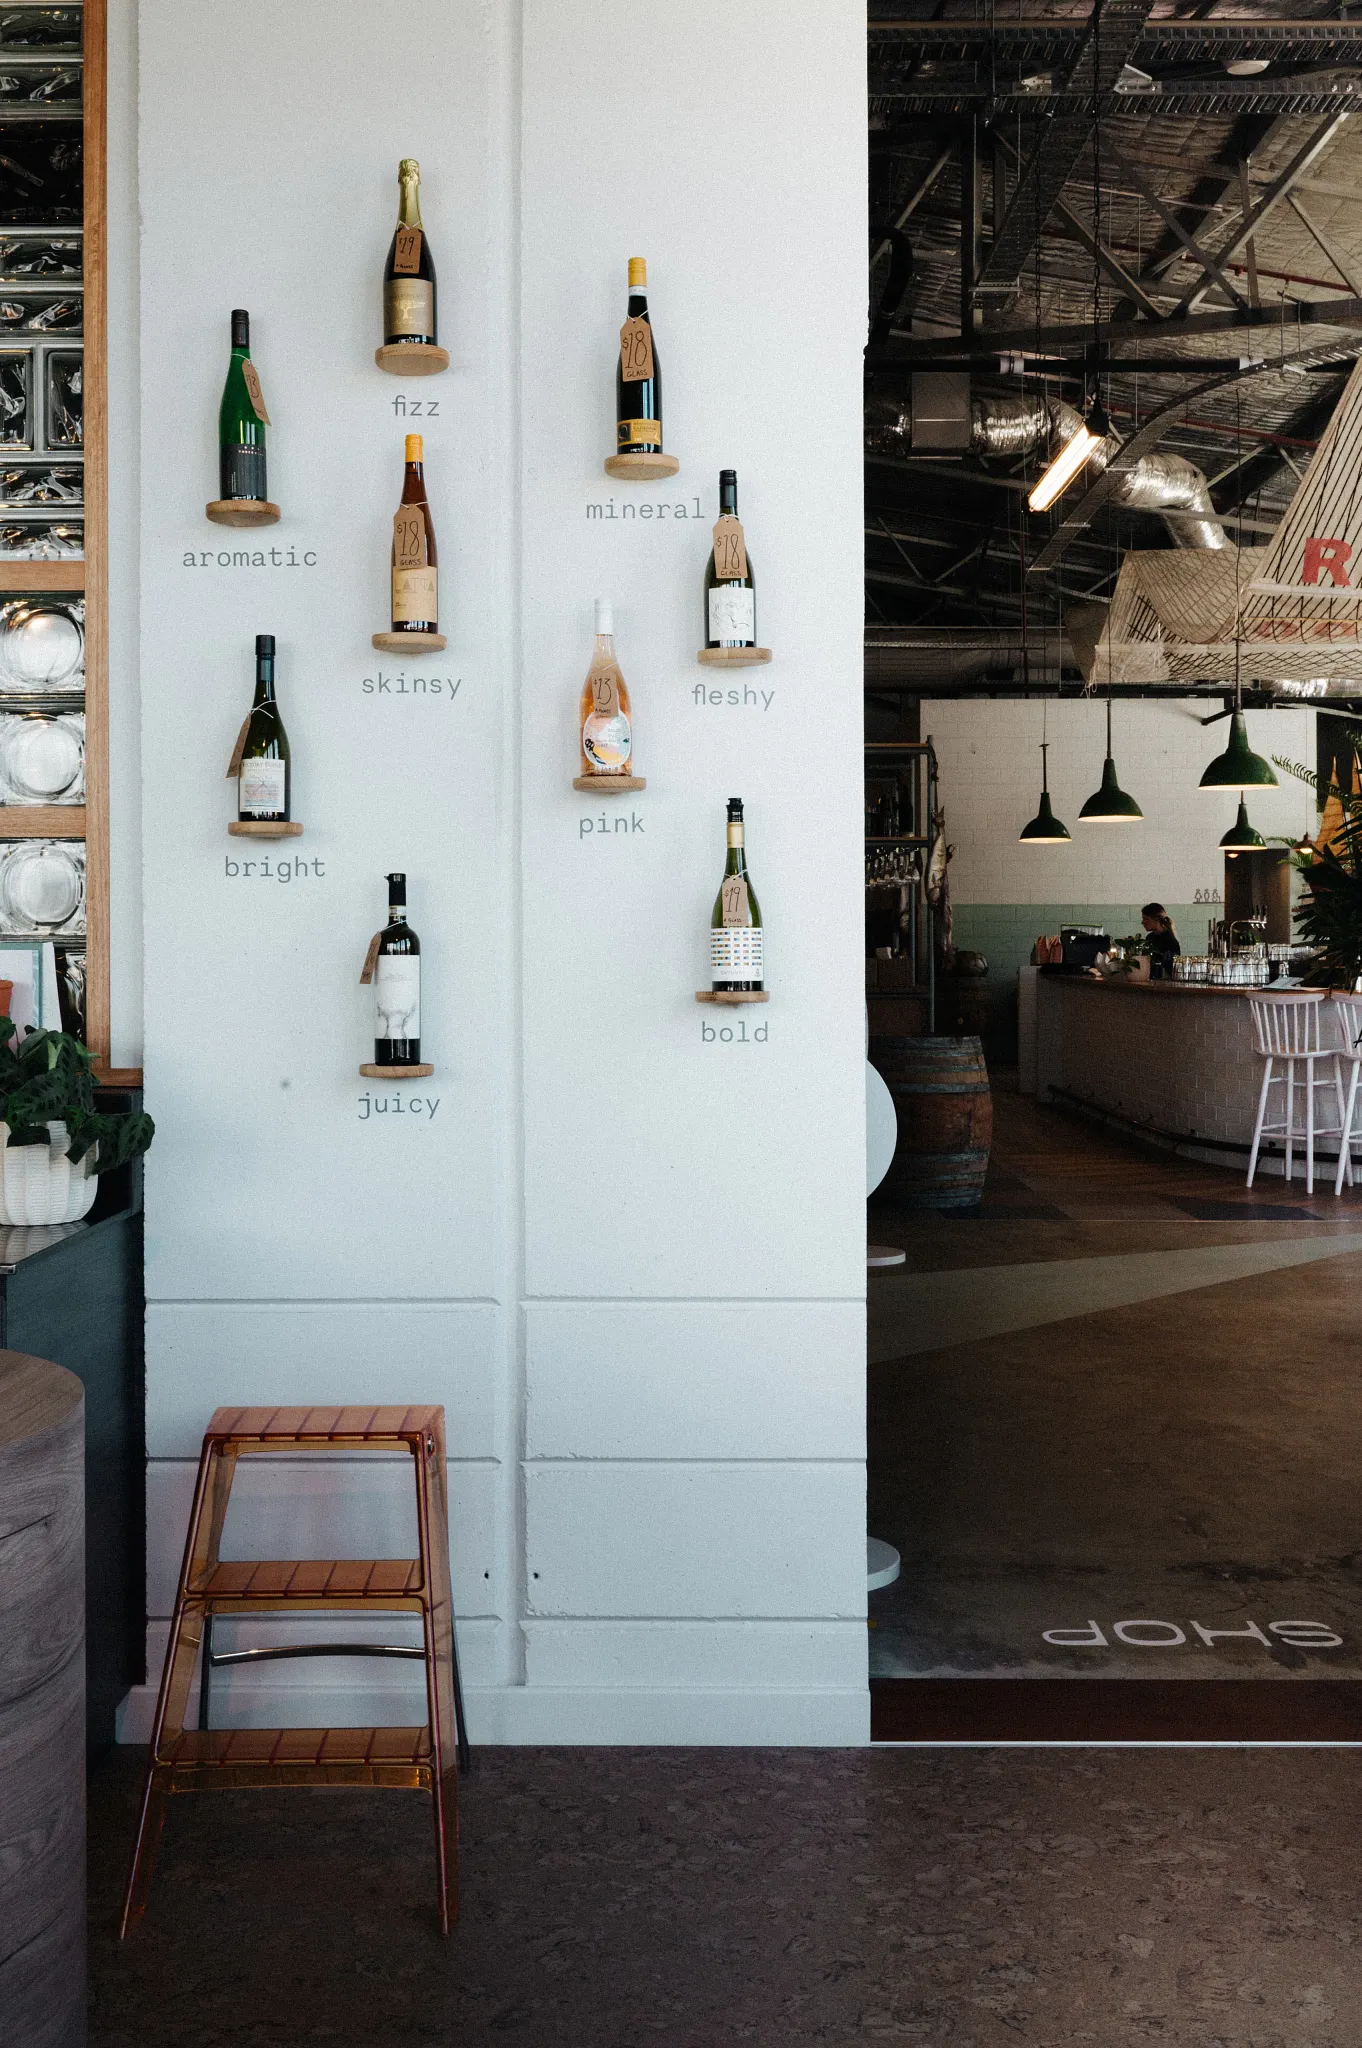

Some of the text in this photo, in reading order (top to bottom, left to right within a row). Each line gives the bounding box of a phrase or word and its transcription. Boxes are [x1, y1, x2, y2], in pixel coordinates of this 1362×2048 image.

[622, 331, 647, 368] $18
[391, 394, 440, 416] fizz
[586, 497, 704, 518] mineral
[397, 521, 420, 556] $18
[716, 534, 740, 569] $18
[183, 546, 317, 566] aromatic
[1302, 537, 1351, 586] R
[362, 672, 462, 700] skinsy
[594, 678, 611, 705] $13
[691, 684, 775, 711] fleshy
[579, 812, 645, 839] pink
[225, 855, 326, 884] bright
[724, 887, 740, 912] $19
[702, 1020, 768, 1043] bold
[357, 1091, 440, 1120] juicy
[1042, 1619, 1343, 1647] SHOP
